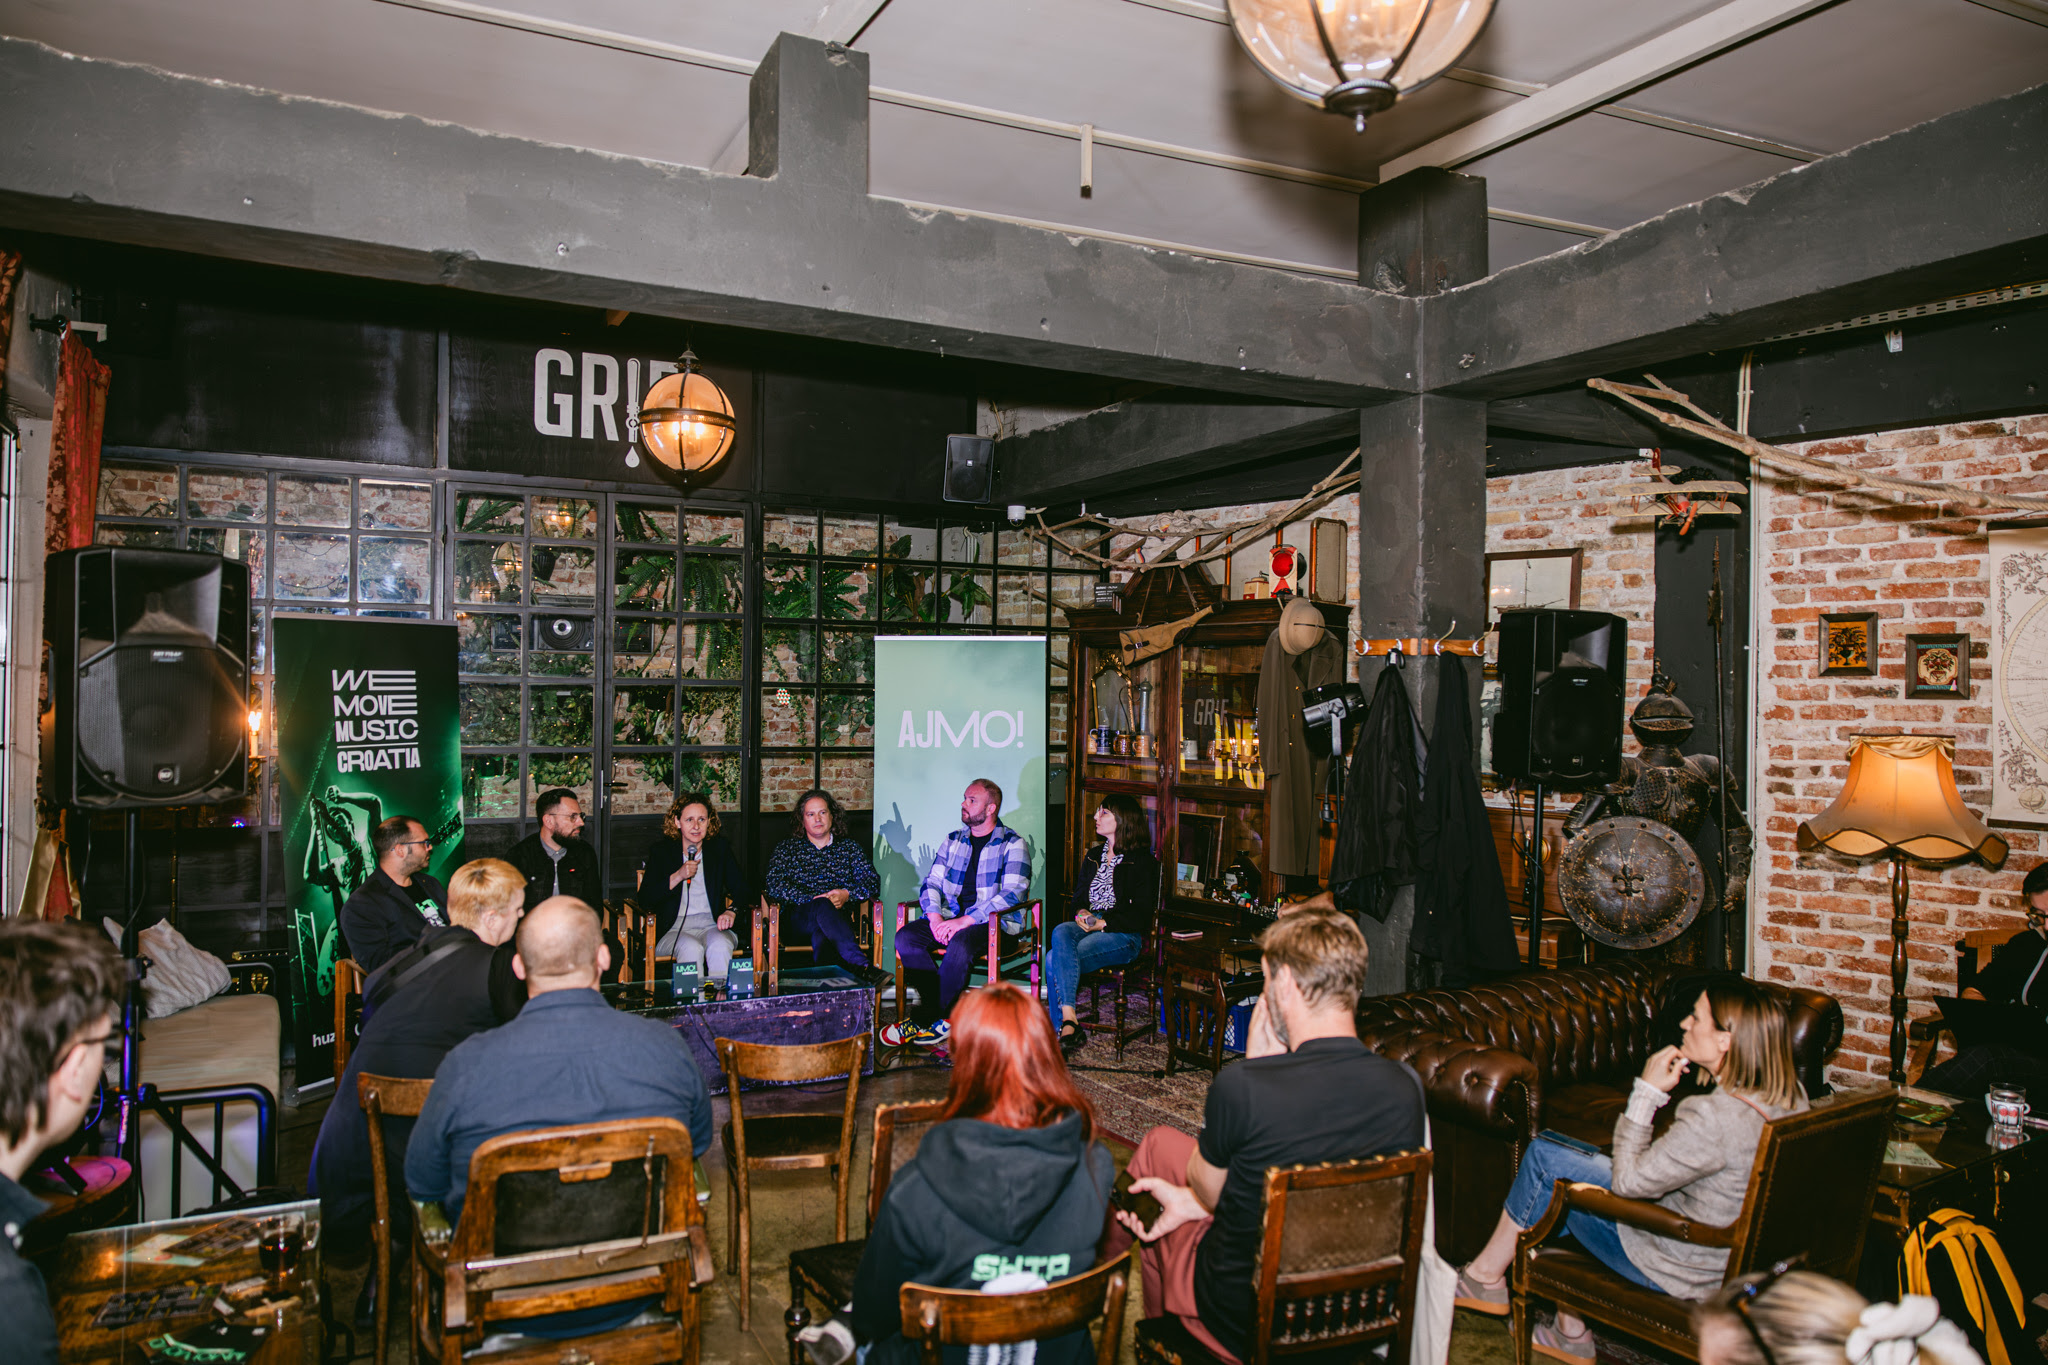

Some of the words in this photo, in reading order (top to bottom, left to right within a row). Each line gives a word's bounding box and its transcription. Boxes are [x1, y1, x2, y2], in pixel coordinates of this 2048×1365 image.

[332, 669, 417, 691] WE
[333, 694, 418, 717] MOVE
[335, 718, 419, 742] MUSIC
[898, 710, 1024, 748] AJMO!
[337, 748, 421, 773] CROATIA
[312, 1032, 336, 1048] huz
